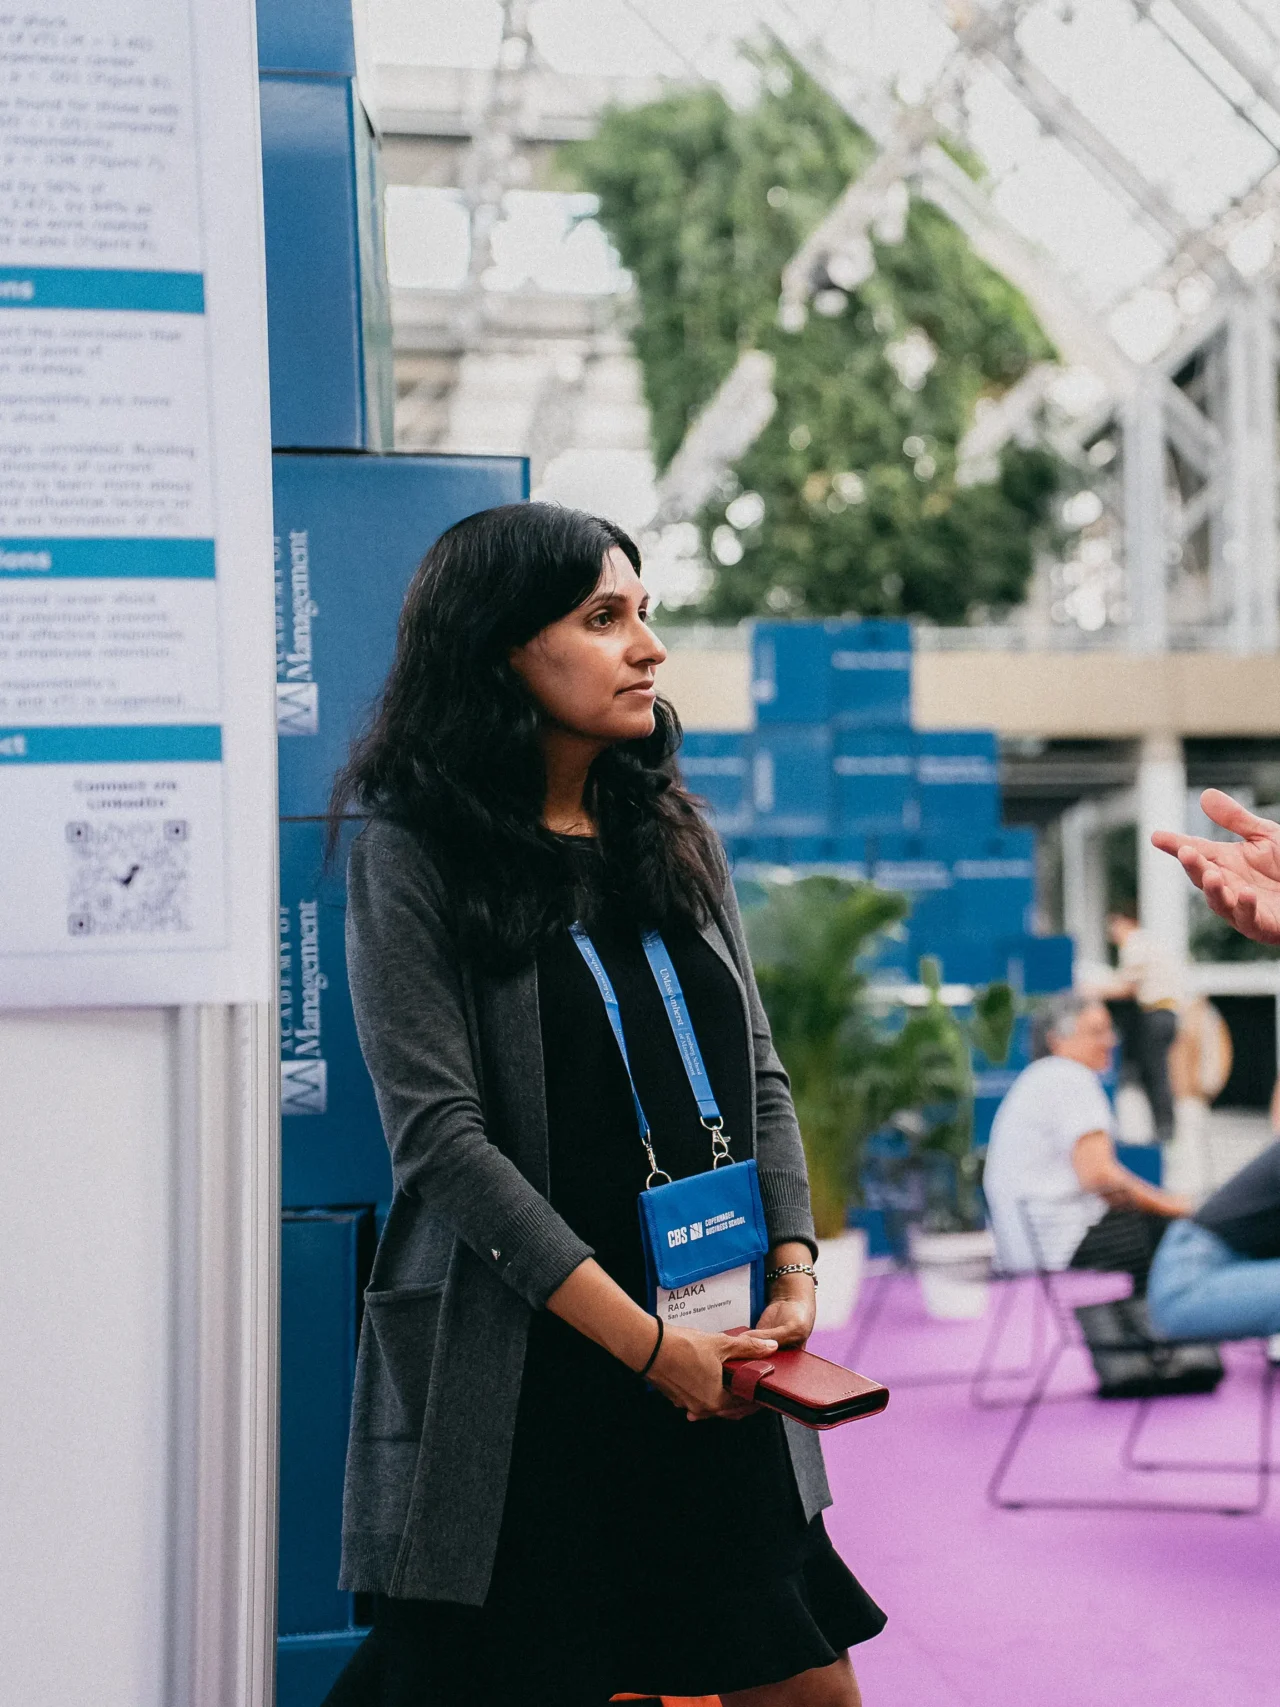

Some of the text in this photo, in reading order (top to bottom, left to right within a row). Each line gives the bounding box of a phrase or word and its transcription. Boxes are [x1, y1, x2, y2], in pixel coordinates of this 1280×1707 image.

[286, 529, 319, 681] Management
[294, 899, 329, 1057] Management
[659, 967, 684, 1026] UMassAmherst
[705, 1210, 735, 1227] COPENHAGEN
[705, 1216, 746, 1236] BUSINESS SCHOOL
[667, 1226, 688, 1248] CBS
[667, 1284, 706, 1301] ALAKA
[667, 1301, 686, 1313] RAO
[667, 1300, 732, 1320] San Jose State University
